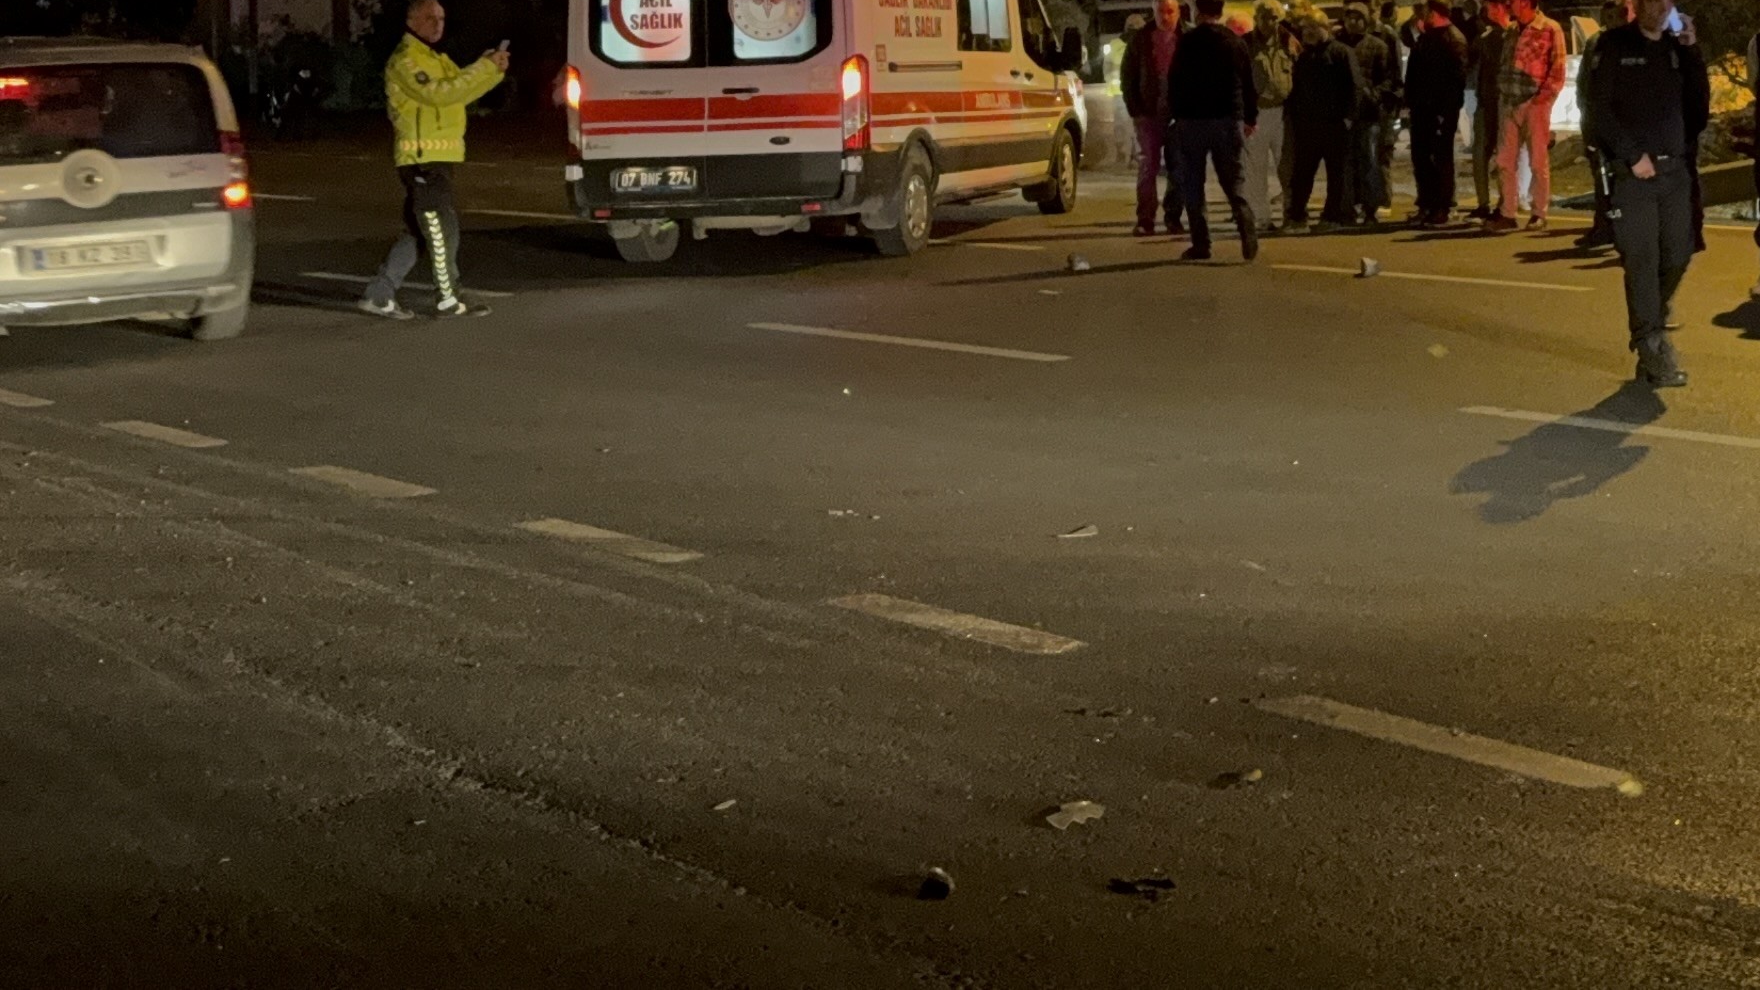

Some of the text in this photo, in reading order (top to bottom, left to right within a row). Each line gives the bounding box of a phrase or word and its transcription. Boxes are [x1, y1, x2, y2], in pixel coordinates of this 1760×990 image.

[629, 11, 683, 30] SAĞLIK
[621, 172, 636, 187] 07
[668, 171, 691, 186] 274
